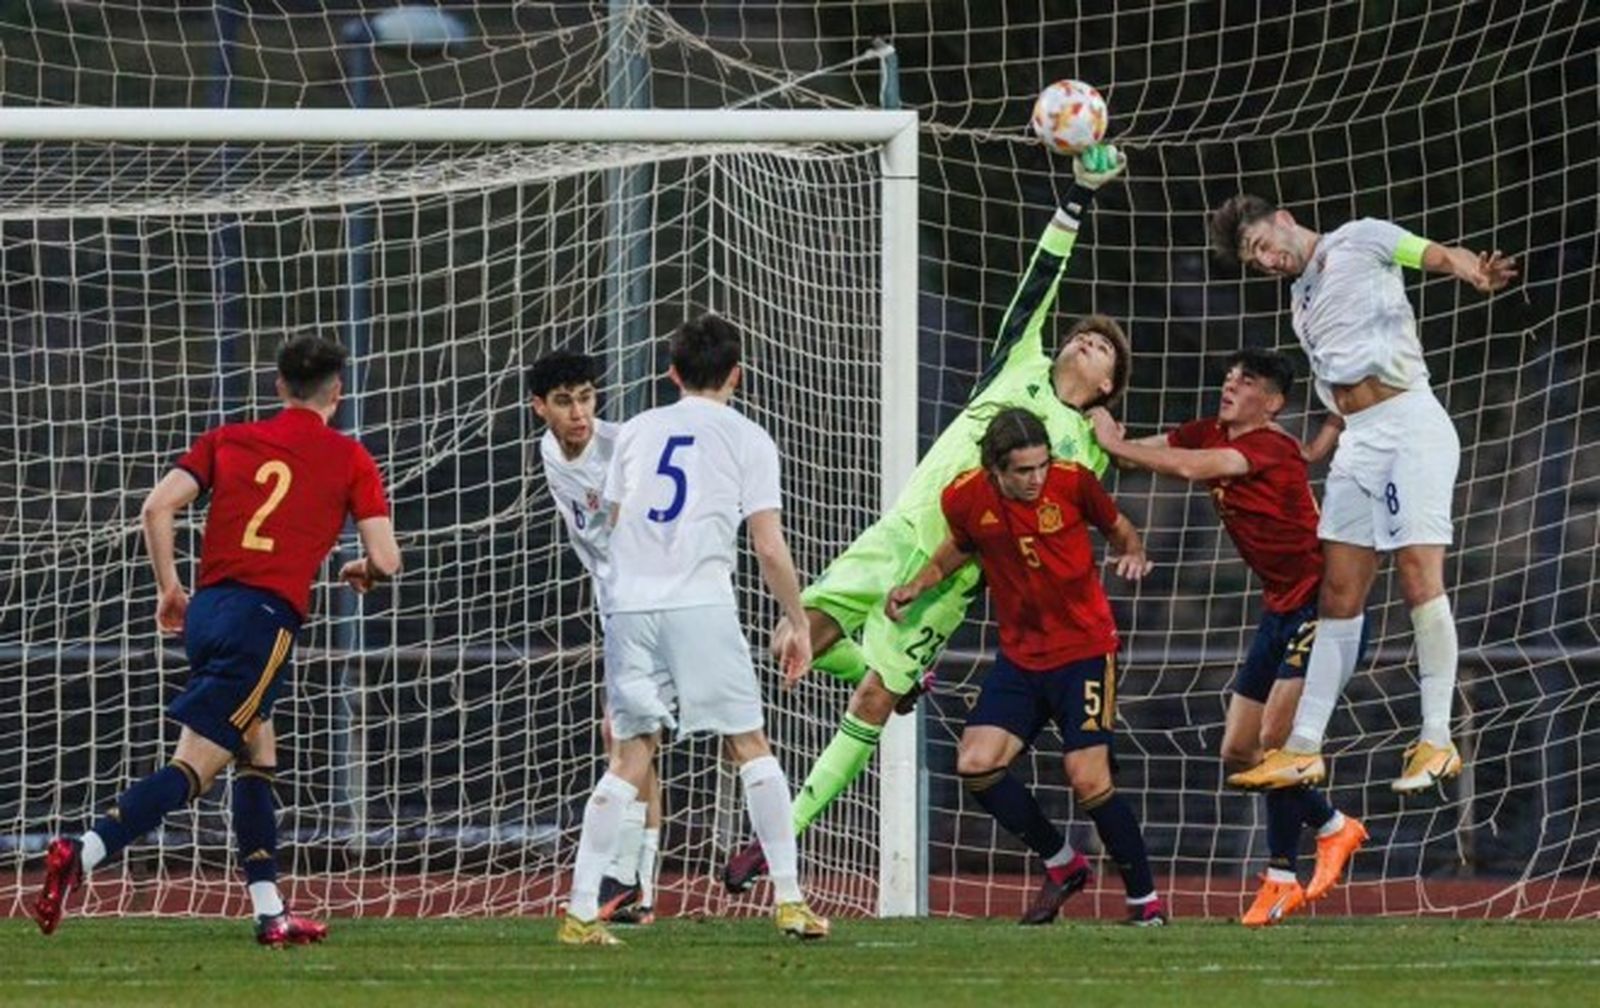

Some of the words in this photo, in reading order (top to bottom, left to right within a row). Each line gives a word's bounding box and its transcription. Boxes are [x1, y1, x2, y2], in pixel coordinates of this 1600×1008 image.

[648, 436, 695, 522] 5
[241, 460, 292, 551] 2
[572, 500, 585, 530] 6
[1385, 482, 1399, 515] 8
[1020, 537, 1041, 568] 5
[905, 626, 945, 665] 23
[1084, 680, 1101, 716] 5
